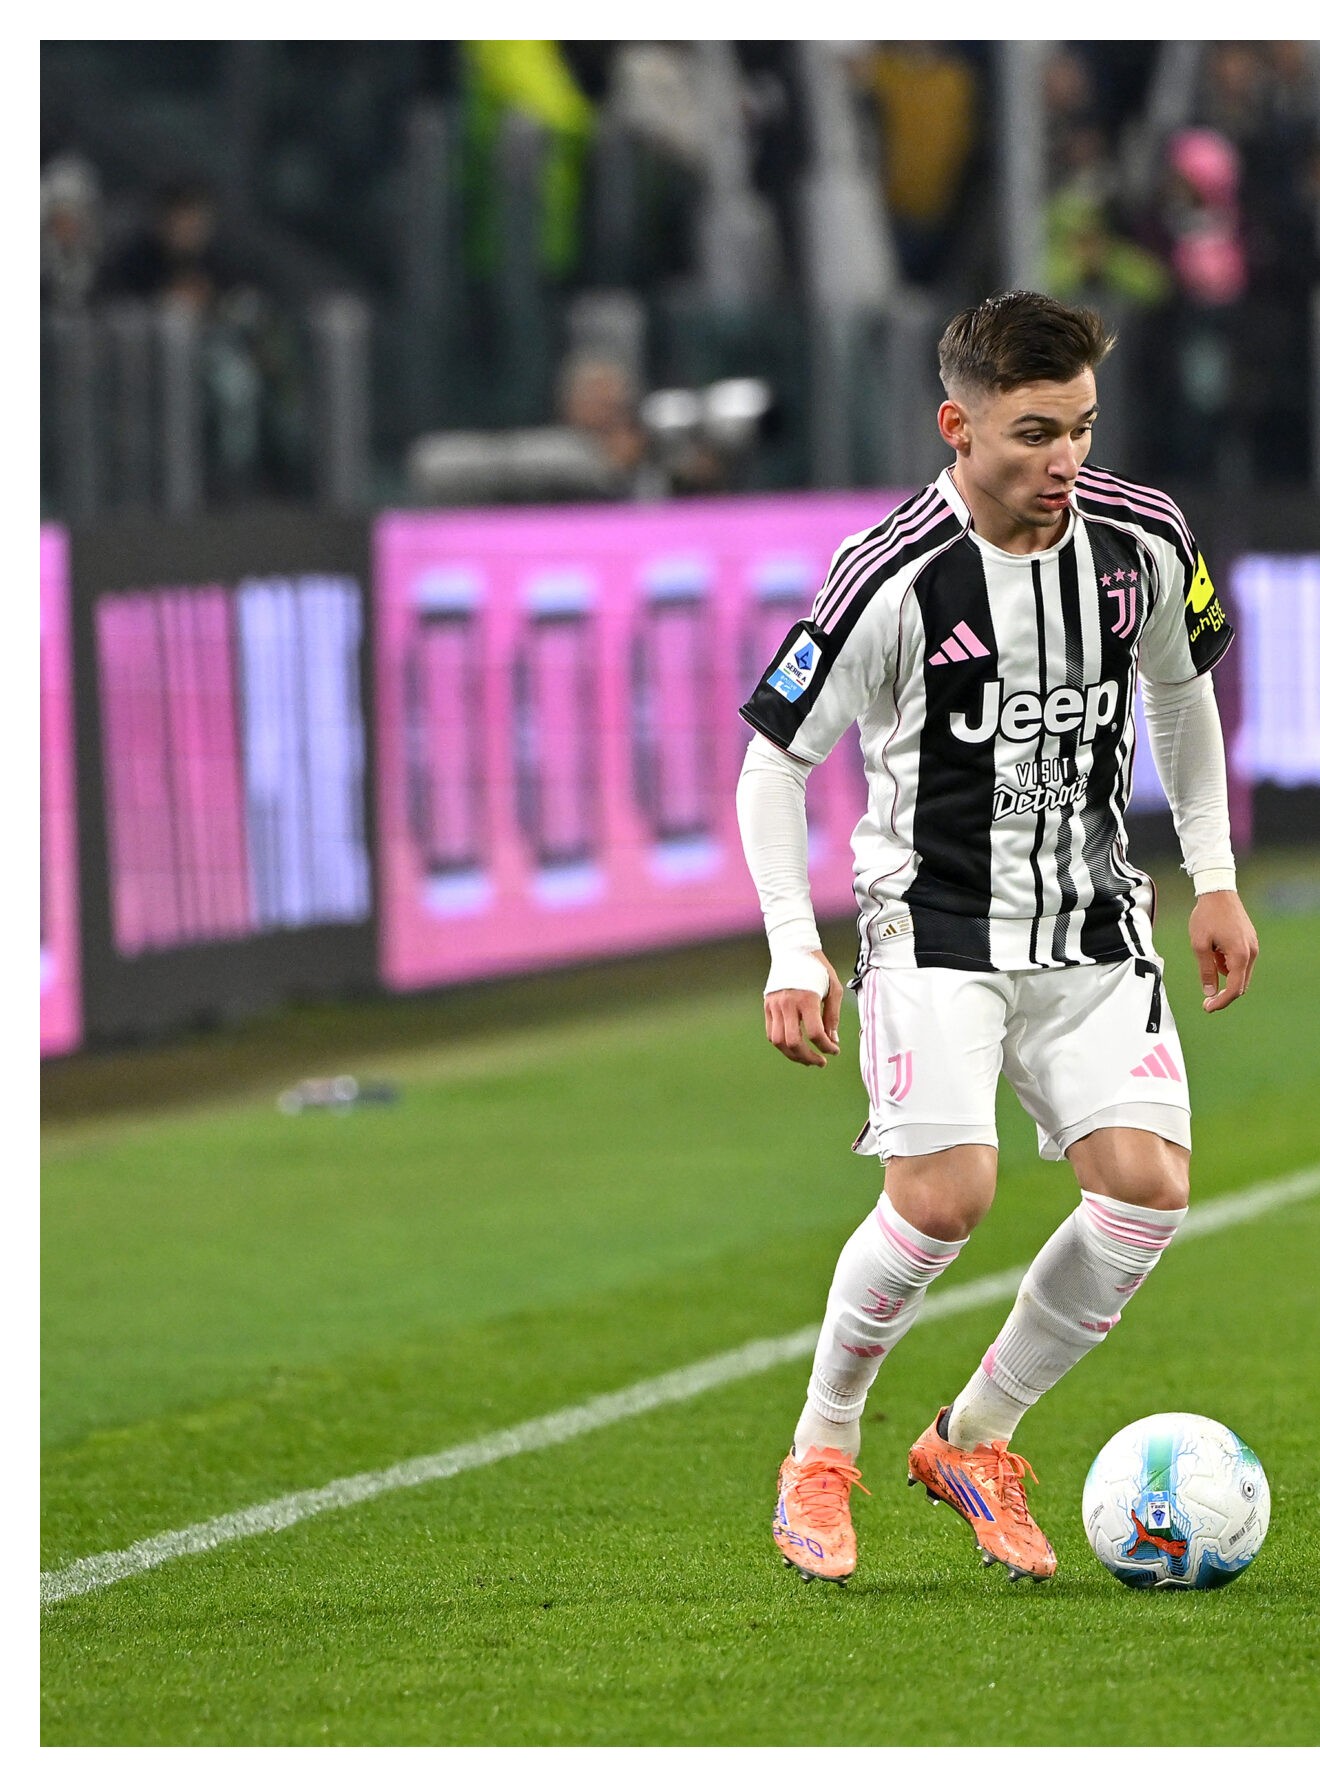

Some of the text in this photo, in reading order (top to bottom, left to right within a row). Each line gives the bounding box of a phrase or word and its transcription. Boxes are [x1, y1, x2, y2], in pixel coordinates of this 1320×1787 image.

[785, 662, 803, 678] SERIE
[949, 679, 1119, 744] Jeep
[1015, 757, 1070, 787] VISIT
[992, 773, 1088, 821] Detroit
[1135, 958, 1161, 1034] 7
